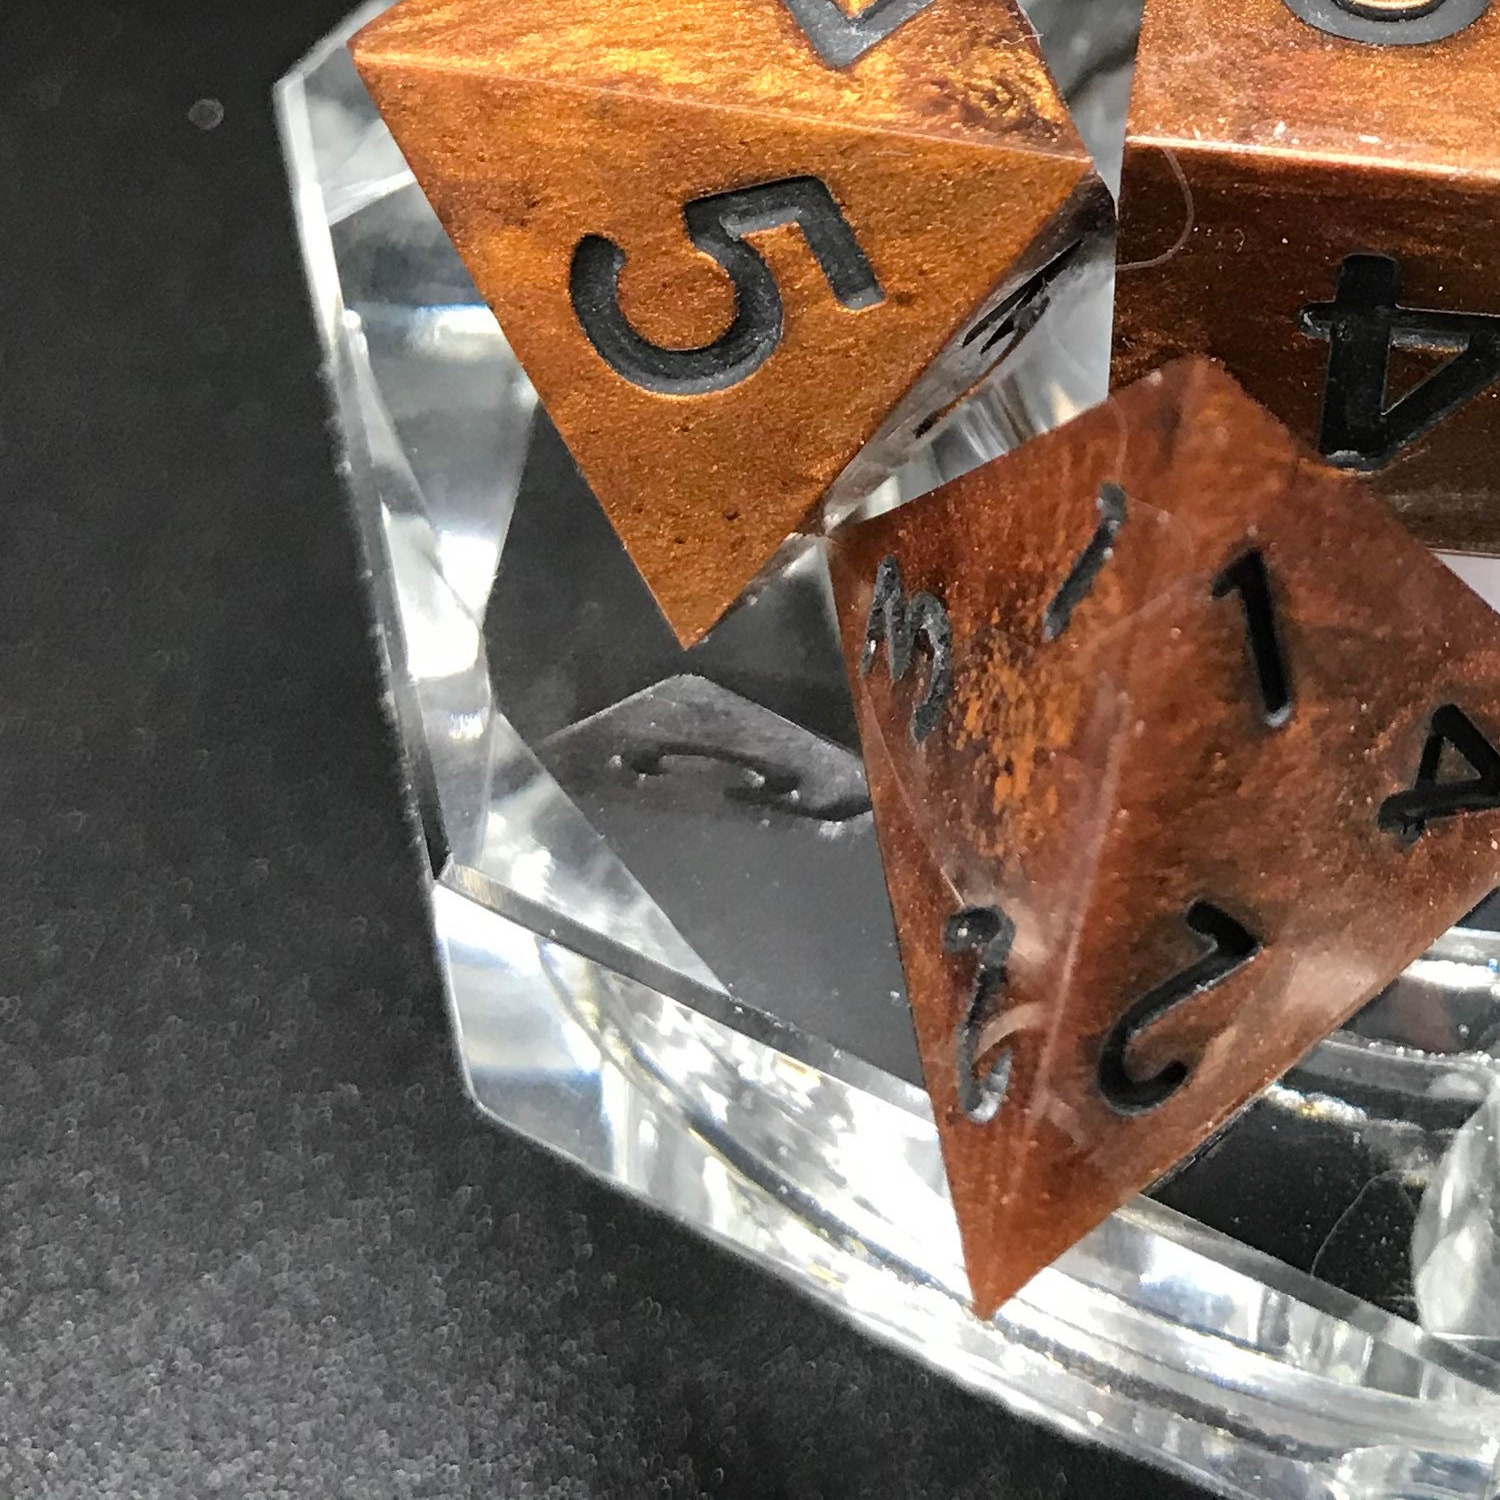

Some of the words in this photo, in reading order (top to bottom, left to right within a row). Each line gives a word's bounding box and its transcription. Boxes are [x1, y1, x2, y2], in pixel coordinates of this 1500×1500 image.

[568, 172, 886, 396] 5
[1041, 480, 1128, 643] 1
[1211, 546, 1297, 728] 1
[1096, 897, 1266, 1116] 2
